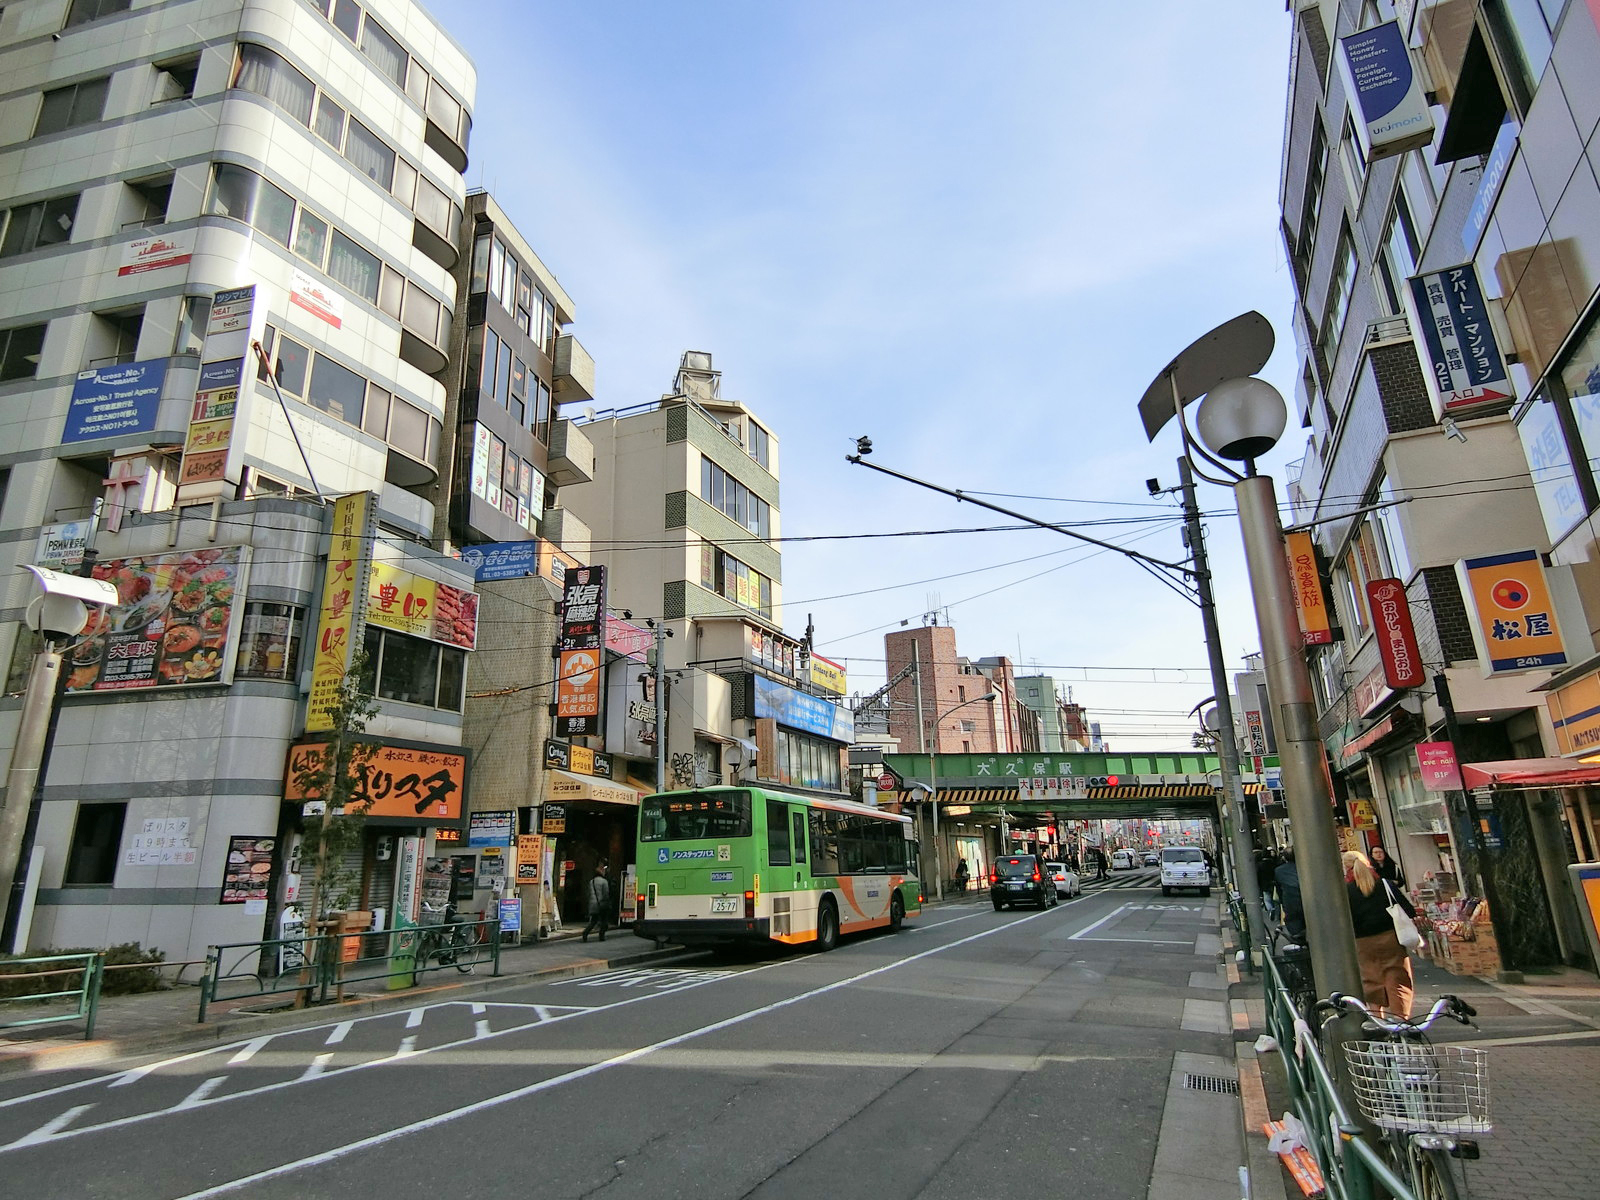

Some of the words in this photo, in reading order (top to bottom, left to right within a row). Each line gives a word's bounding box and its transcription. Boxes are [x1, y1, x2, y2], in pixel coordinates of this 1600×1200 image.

[1347, 37, 1378, 50] Simpler
[1349, 45, 1375, 57] Money
[1351, 48, 1389, 63] Transfers.
[1354, 62, 1379, 74] Easier
[1356, 66, 1387, 80] Foreign
[1358, 71, 1394, 86] Currency
[1360, 76, 1400, 92] Exchange.
[1449, 269, 1492, 382] アパート・マンション
[1437, 314, 1454, 339] 売買
[1446, 347, 1465, 372] 管理
[1435, 361, 1450, 392] 2F
[1450, 388, 1475, 402] 入口
[1492, 612, 1553, 641] 松屋
[563, 637, 576, 648] 2F
[1306, 632, 1322, 644] 2F
[1516, 656, 1542, 667] 24h
[560, 704, 595, 714] 人気点心
[568, 717, 586, 728] 香港
[1573, 725, 1600, 748] MATSU
[384, 749, 414, 763] 水炊き
[1440, 757, 1454, 765] nail
[977, 762, 1072, 776] 大久保駅
[1434, 771, 1449, 779] B1F
[672, 849, 715, 859] ノンステップバス
